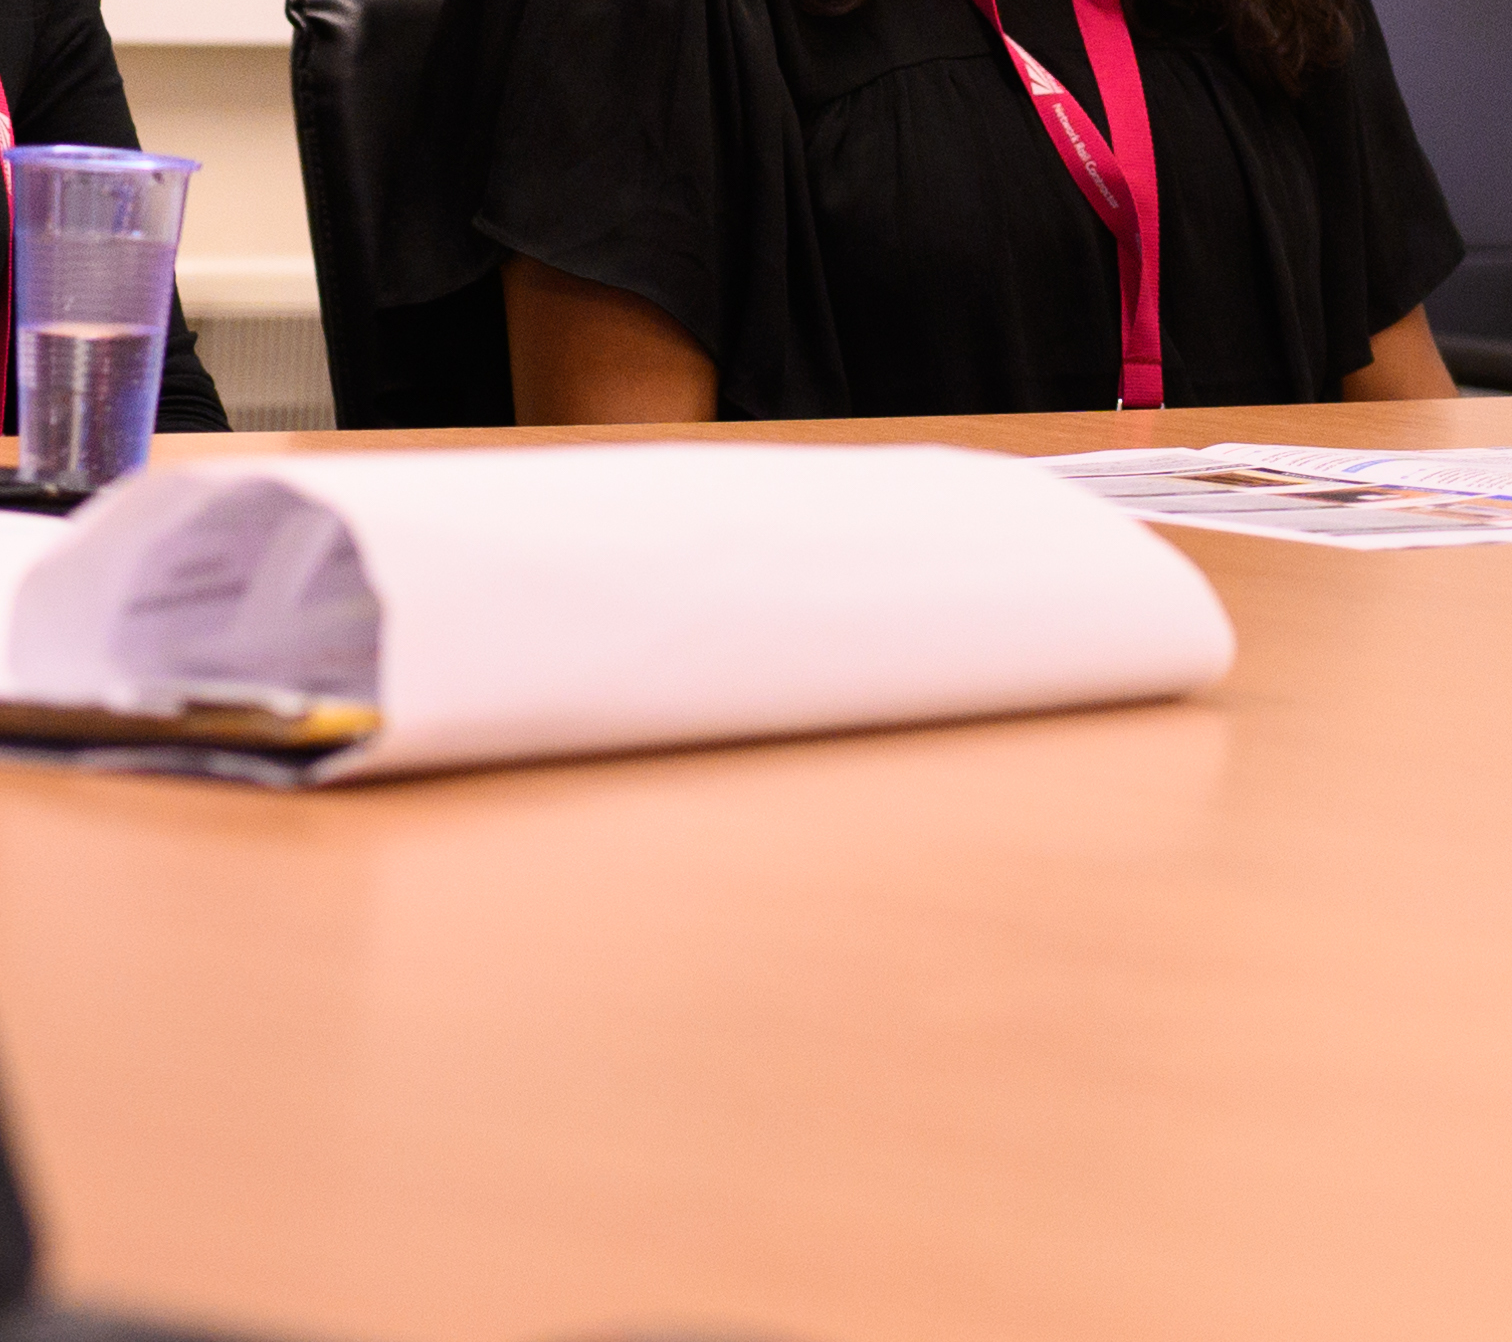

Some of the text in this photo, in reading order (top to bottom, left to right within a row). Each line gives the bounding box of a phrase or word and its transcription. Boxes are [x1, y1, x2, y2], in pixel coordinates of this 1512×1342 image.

[1052, 102, 1120, 209] Network Rail Contractor
